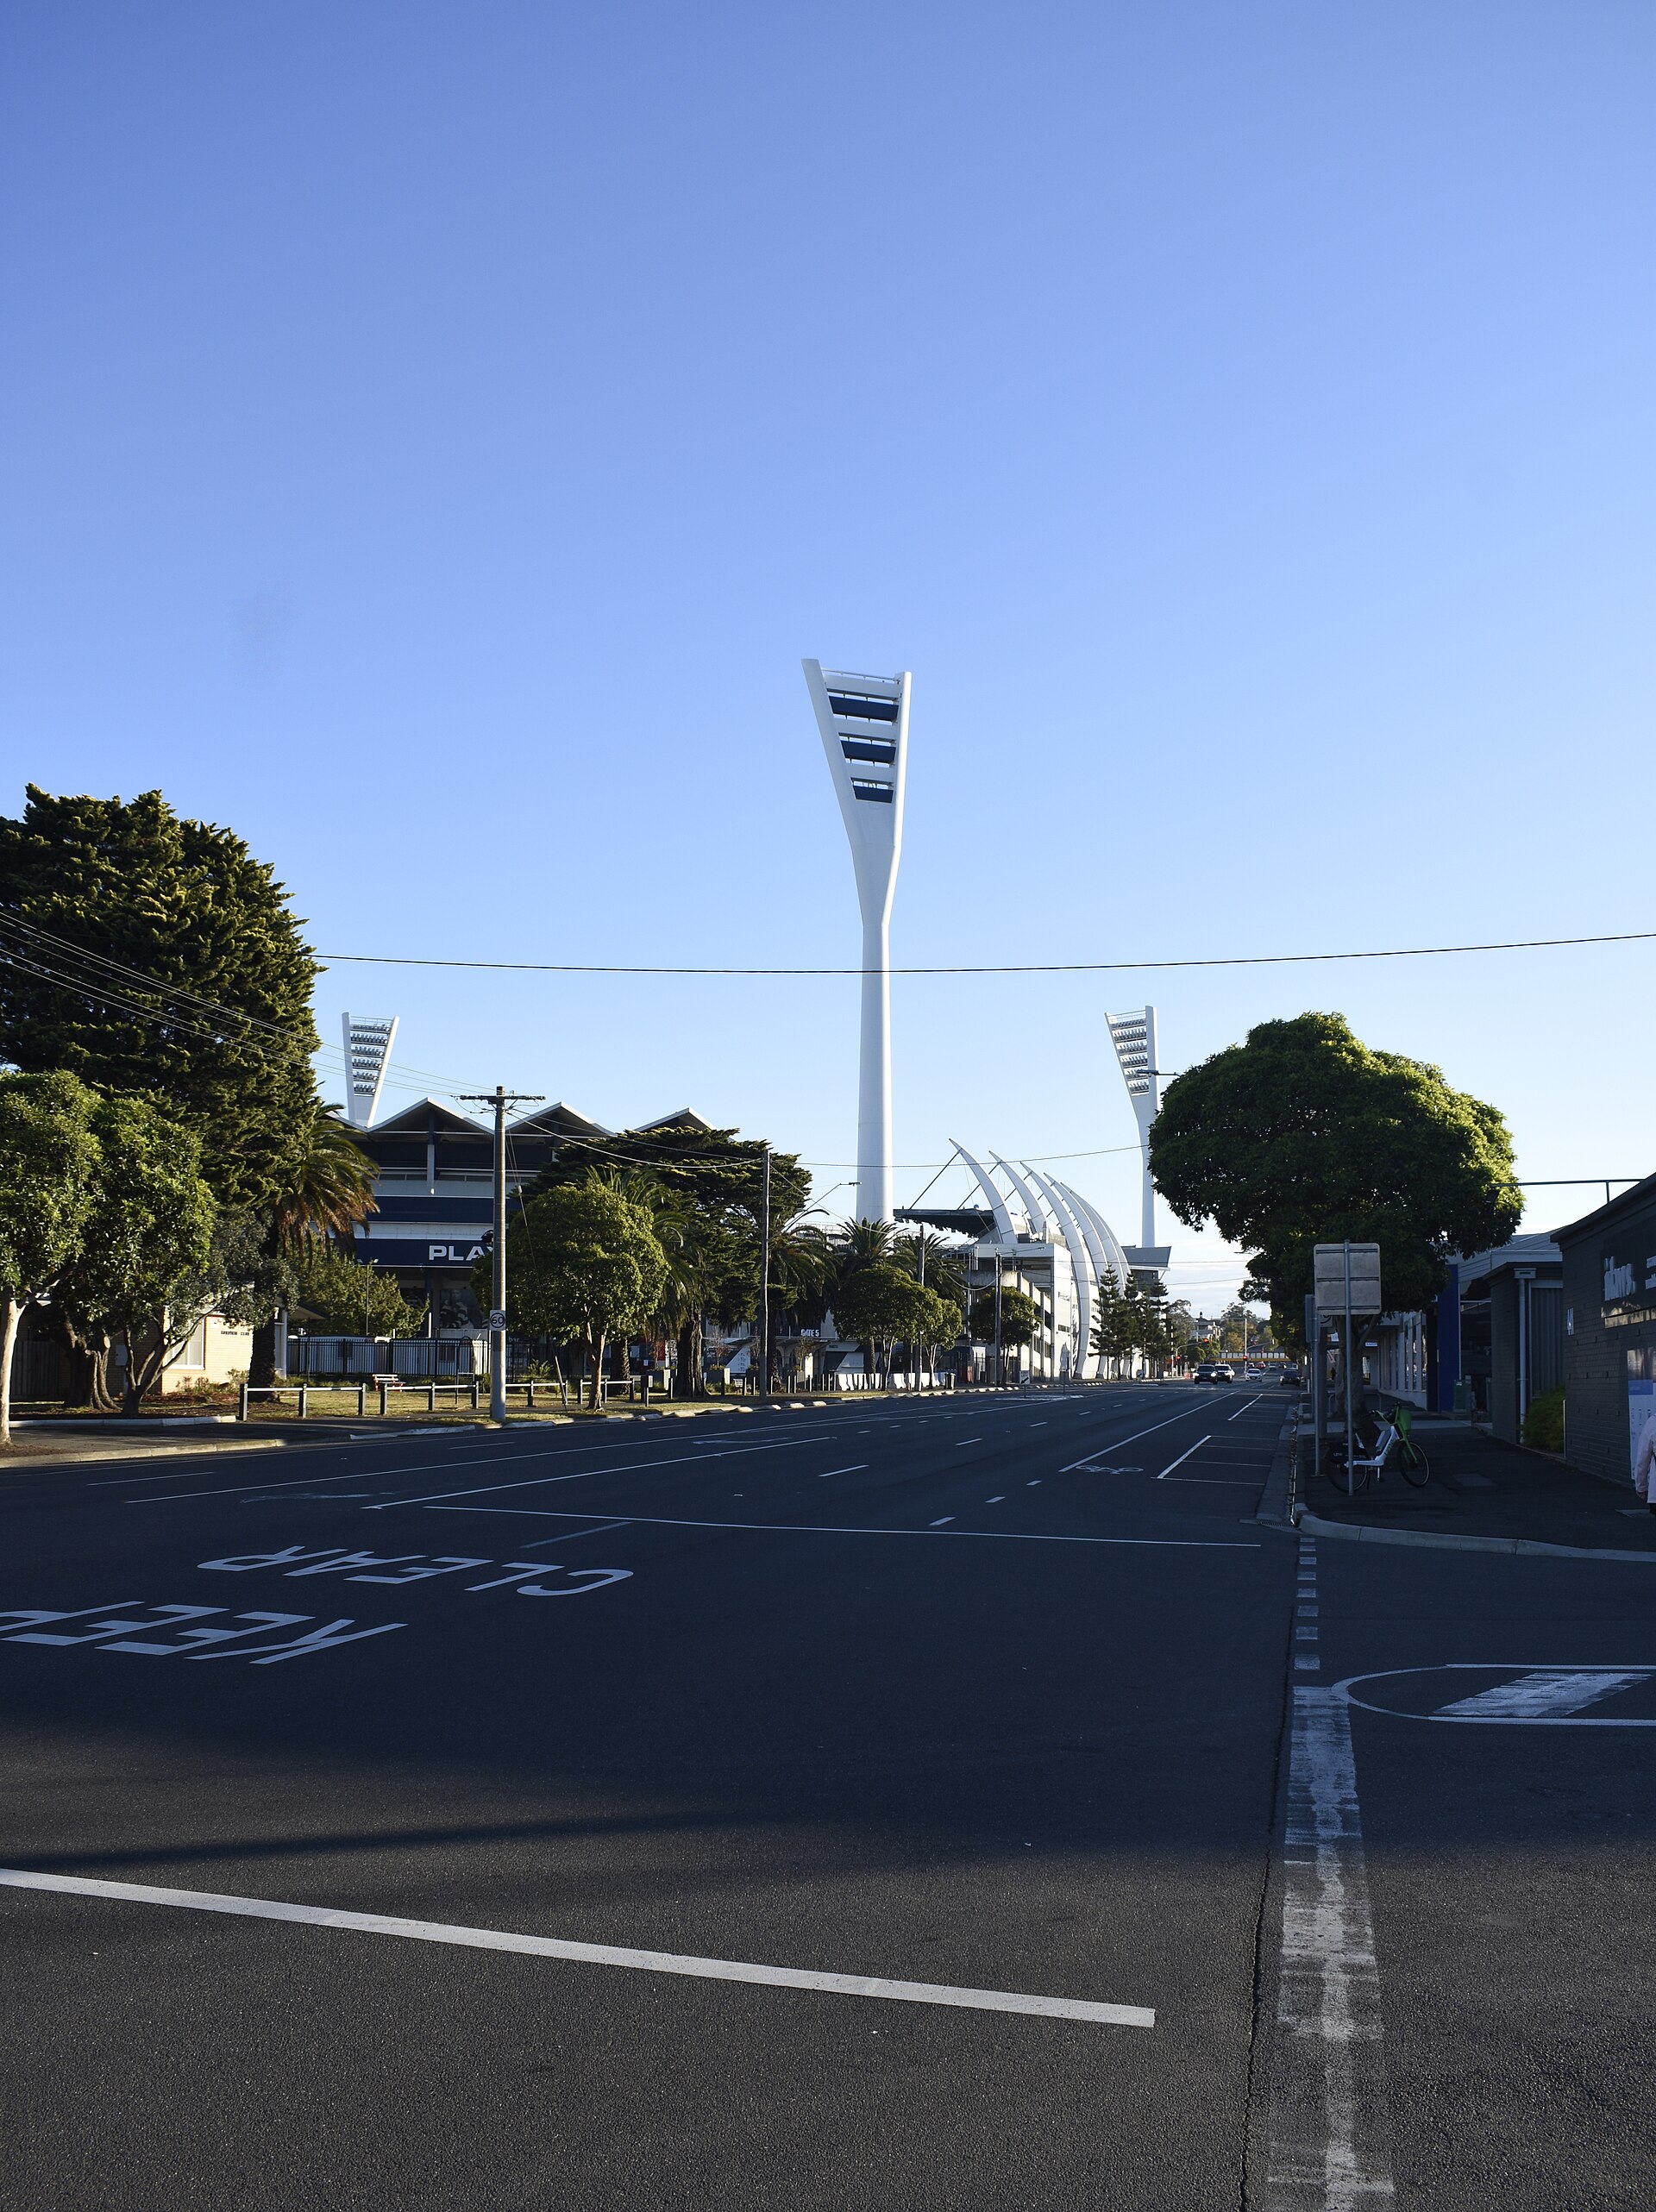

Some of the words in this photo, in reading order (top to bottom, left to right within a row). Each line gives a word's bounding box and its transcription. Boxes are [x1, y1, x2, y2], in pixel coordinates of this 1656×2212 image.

[429, 1245, 494, 1261] PLA
[197, 1545, 634, 1597] CLEAR
[0, 1601, 408, 1664] KEEP
